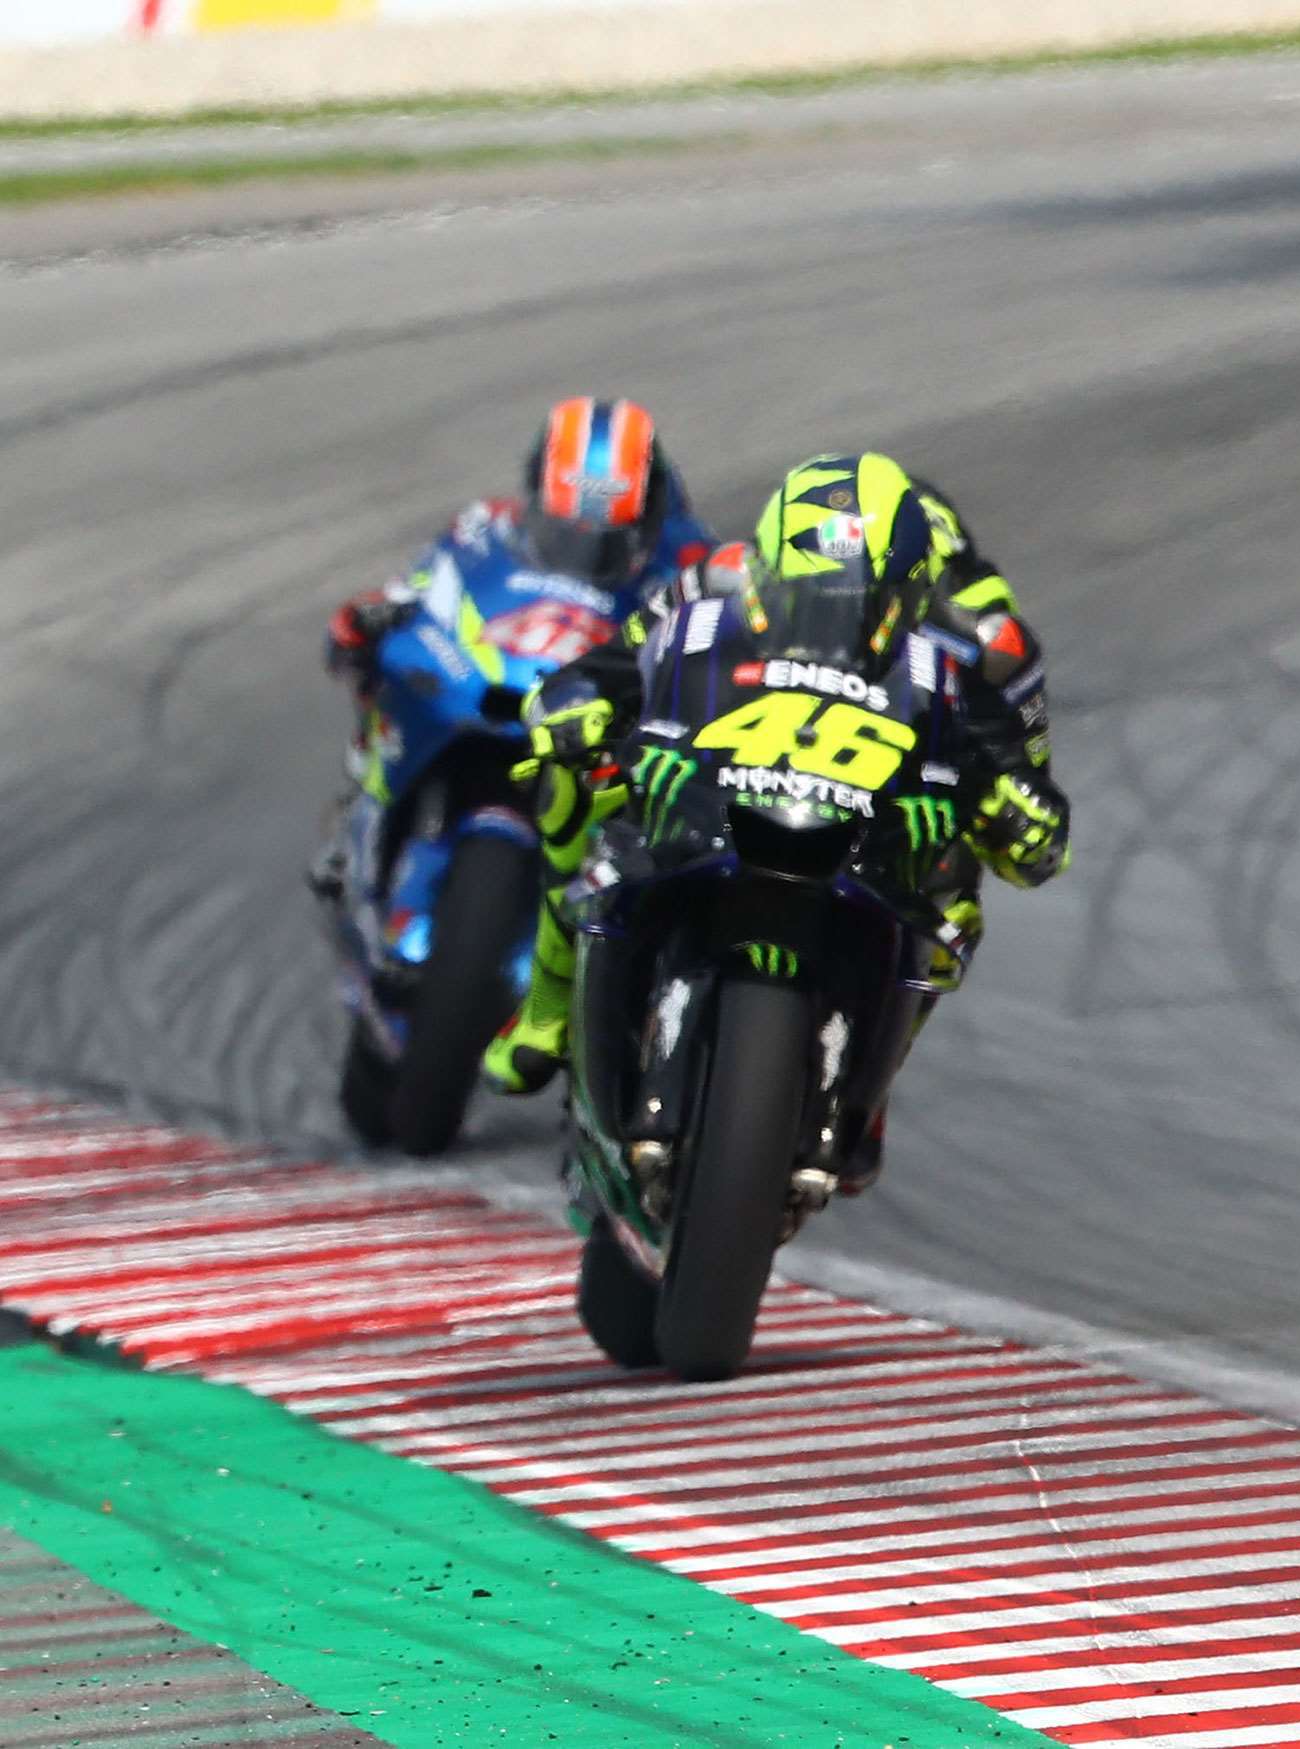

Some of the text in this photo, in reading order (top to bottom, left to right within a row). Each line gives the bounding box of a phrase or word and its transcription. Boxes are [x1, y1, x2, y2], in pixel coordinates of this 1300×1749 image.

[763, 658, 890, 712] ENEOS
[692, 690, 917, 791] 46
[717, 766, 876, 819] MONSTER
